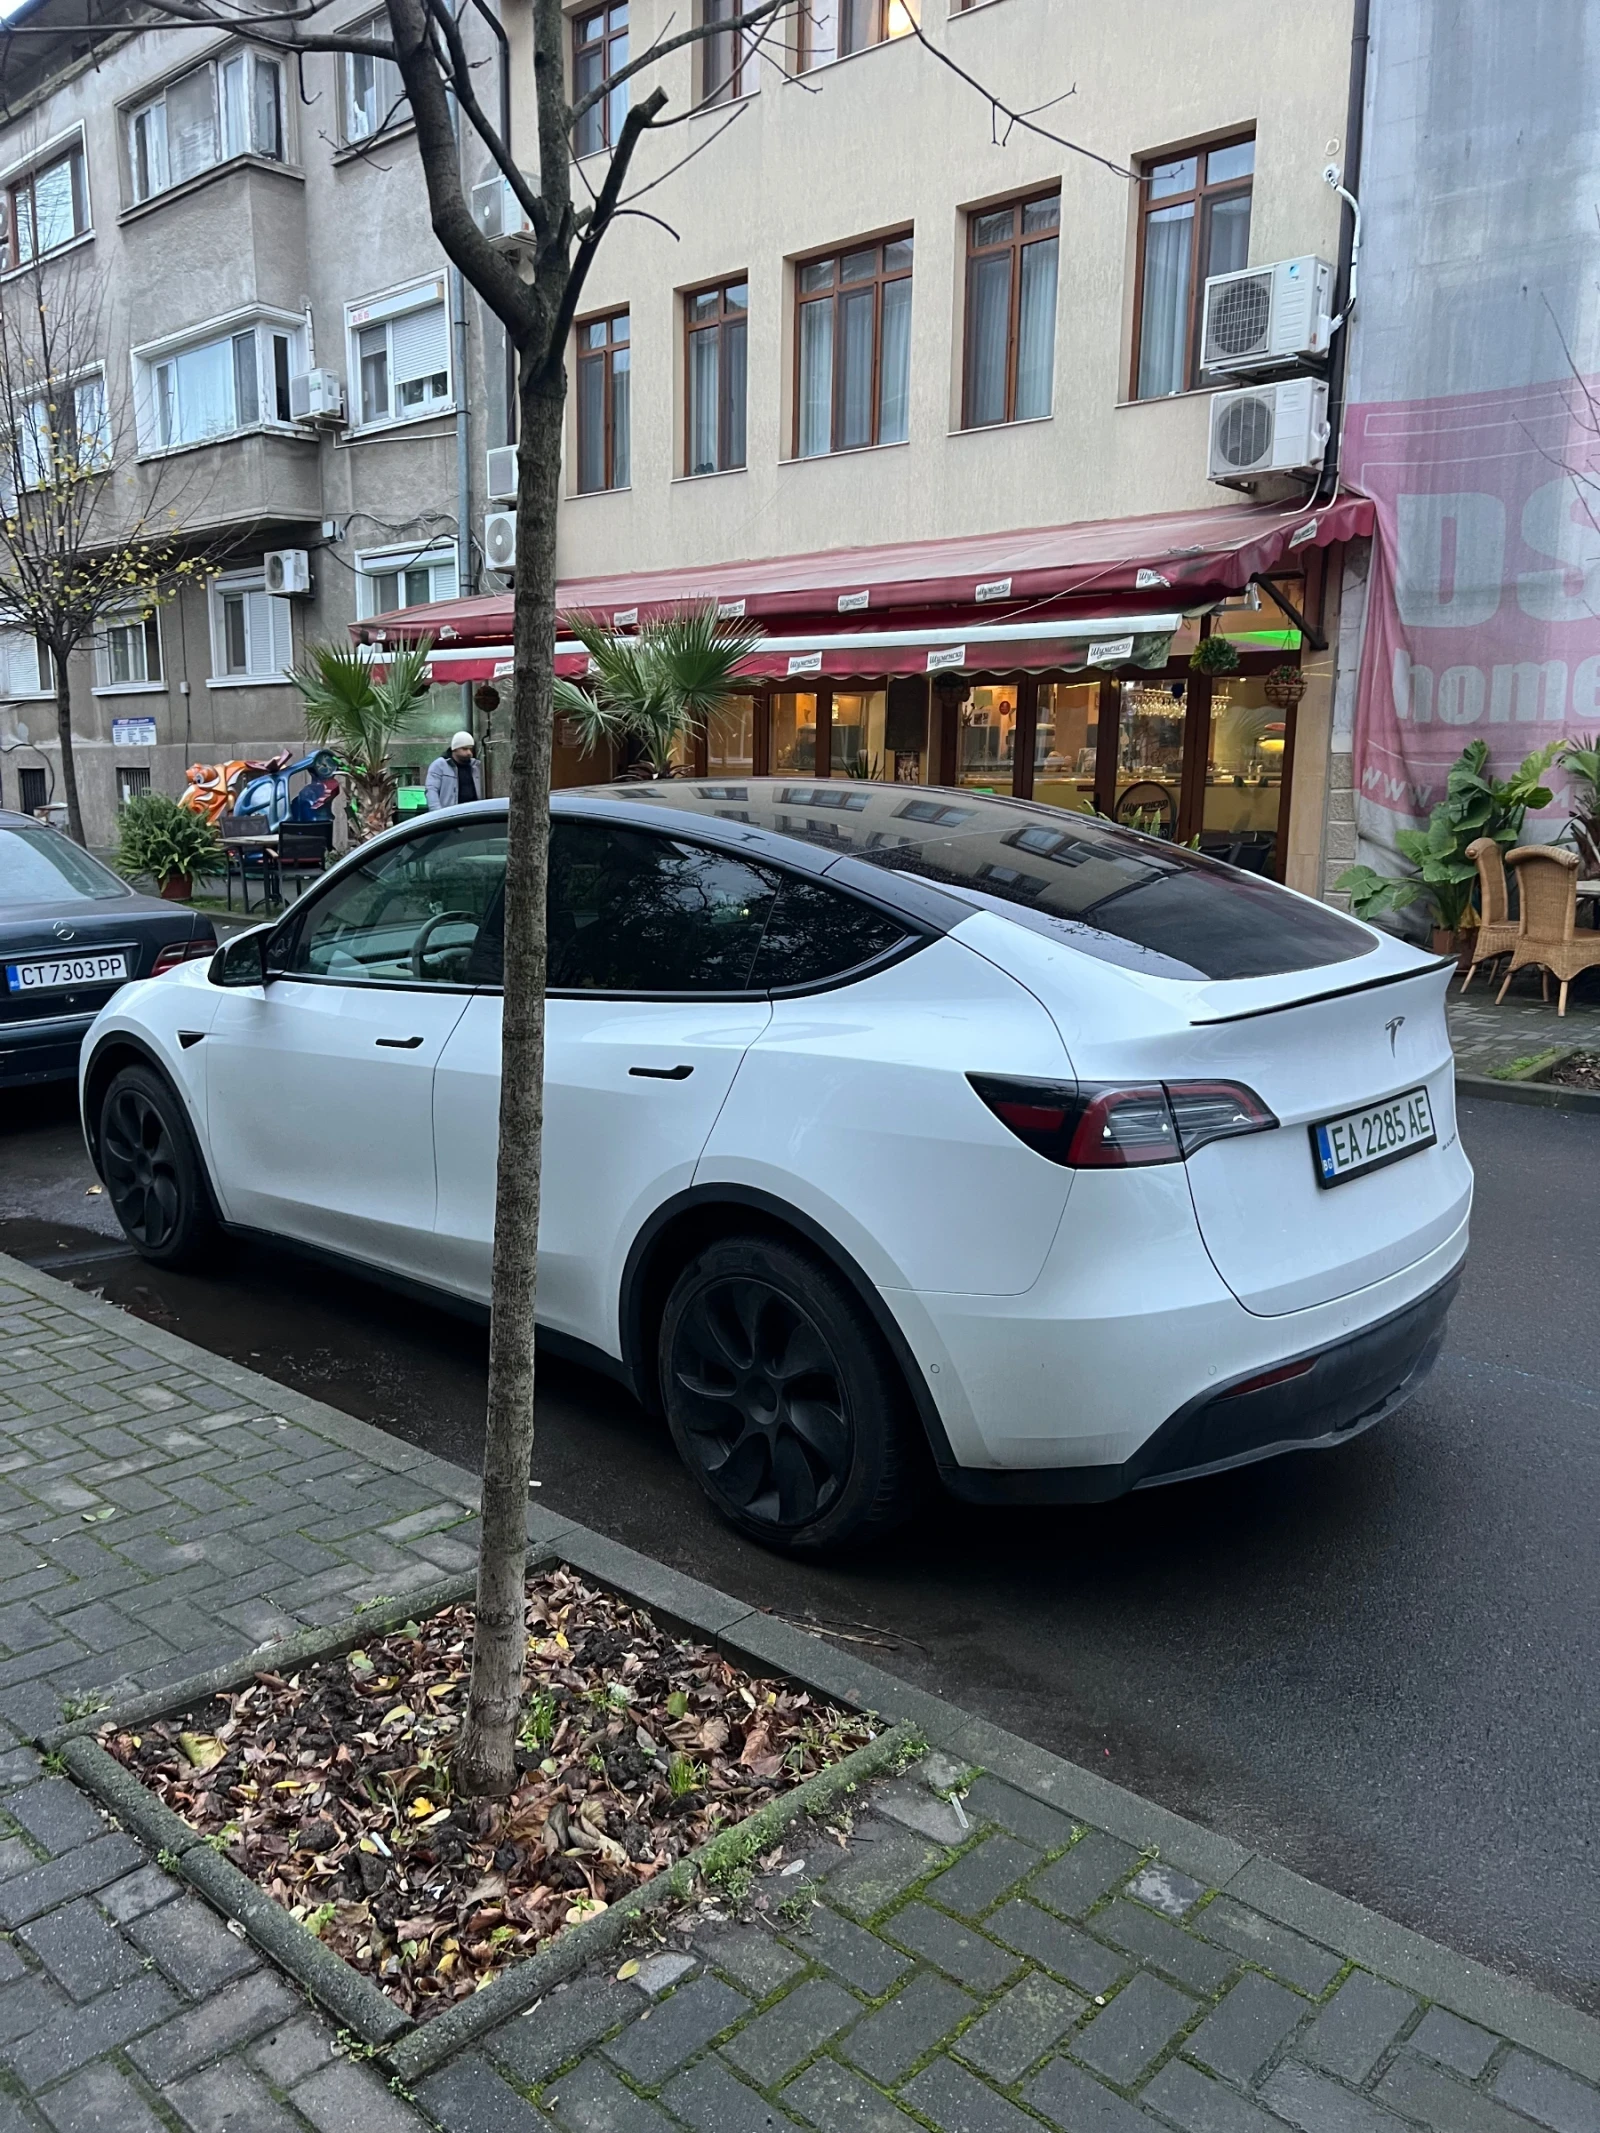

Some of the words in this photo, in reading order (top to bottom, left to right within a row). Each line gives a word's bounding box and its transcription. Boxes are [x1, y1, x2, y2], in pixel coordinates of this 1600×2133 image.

[929, 650, 963, 666] Шуменско
[1091, 642, 1131, 659] Шуменско
[49, 961, 95, 982] 7303
[98, 958, 122, 977] PP
[1331, 1122, 1363, 1168] EA
[1362, 1105, 1406, 1157] 2285
[1407, 1096, 1430, 1138] AE
[1322, 1158, 1333, 1171] BG
